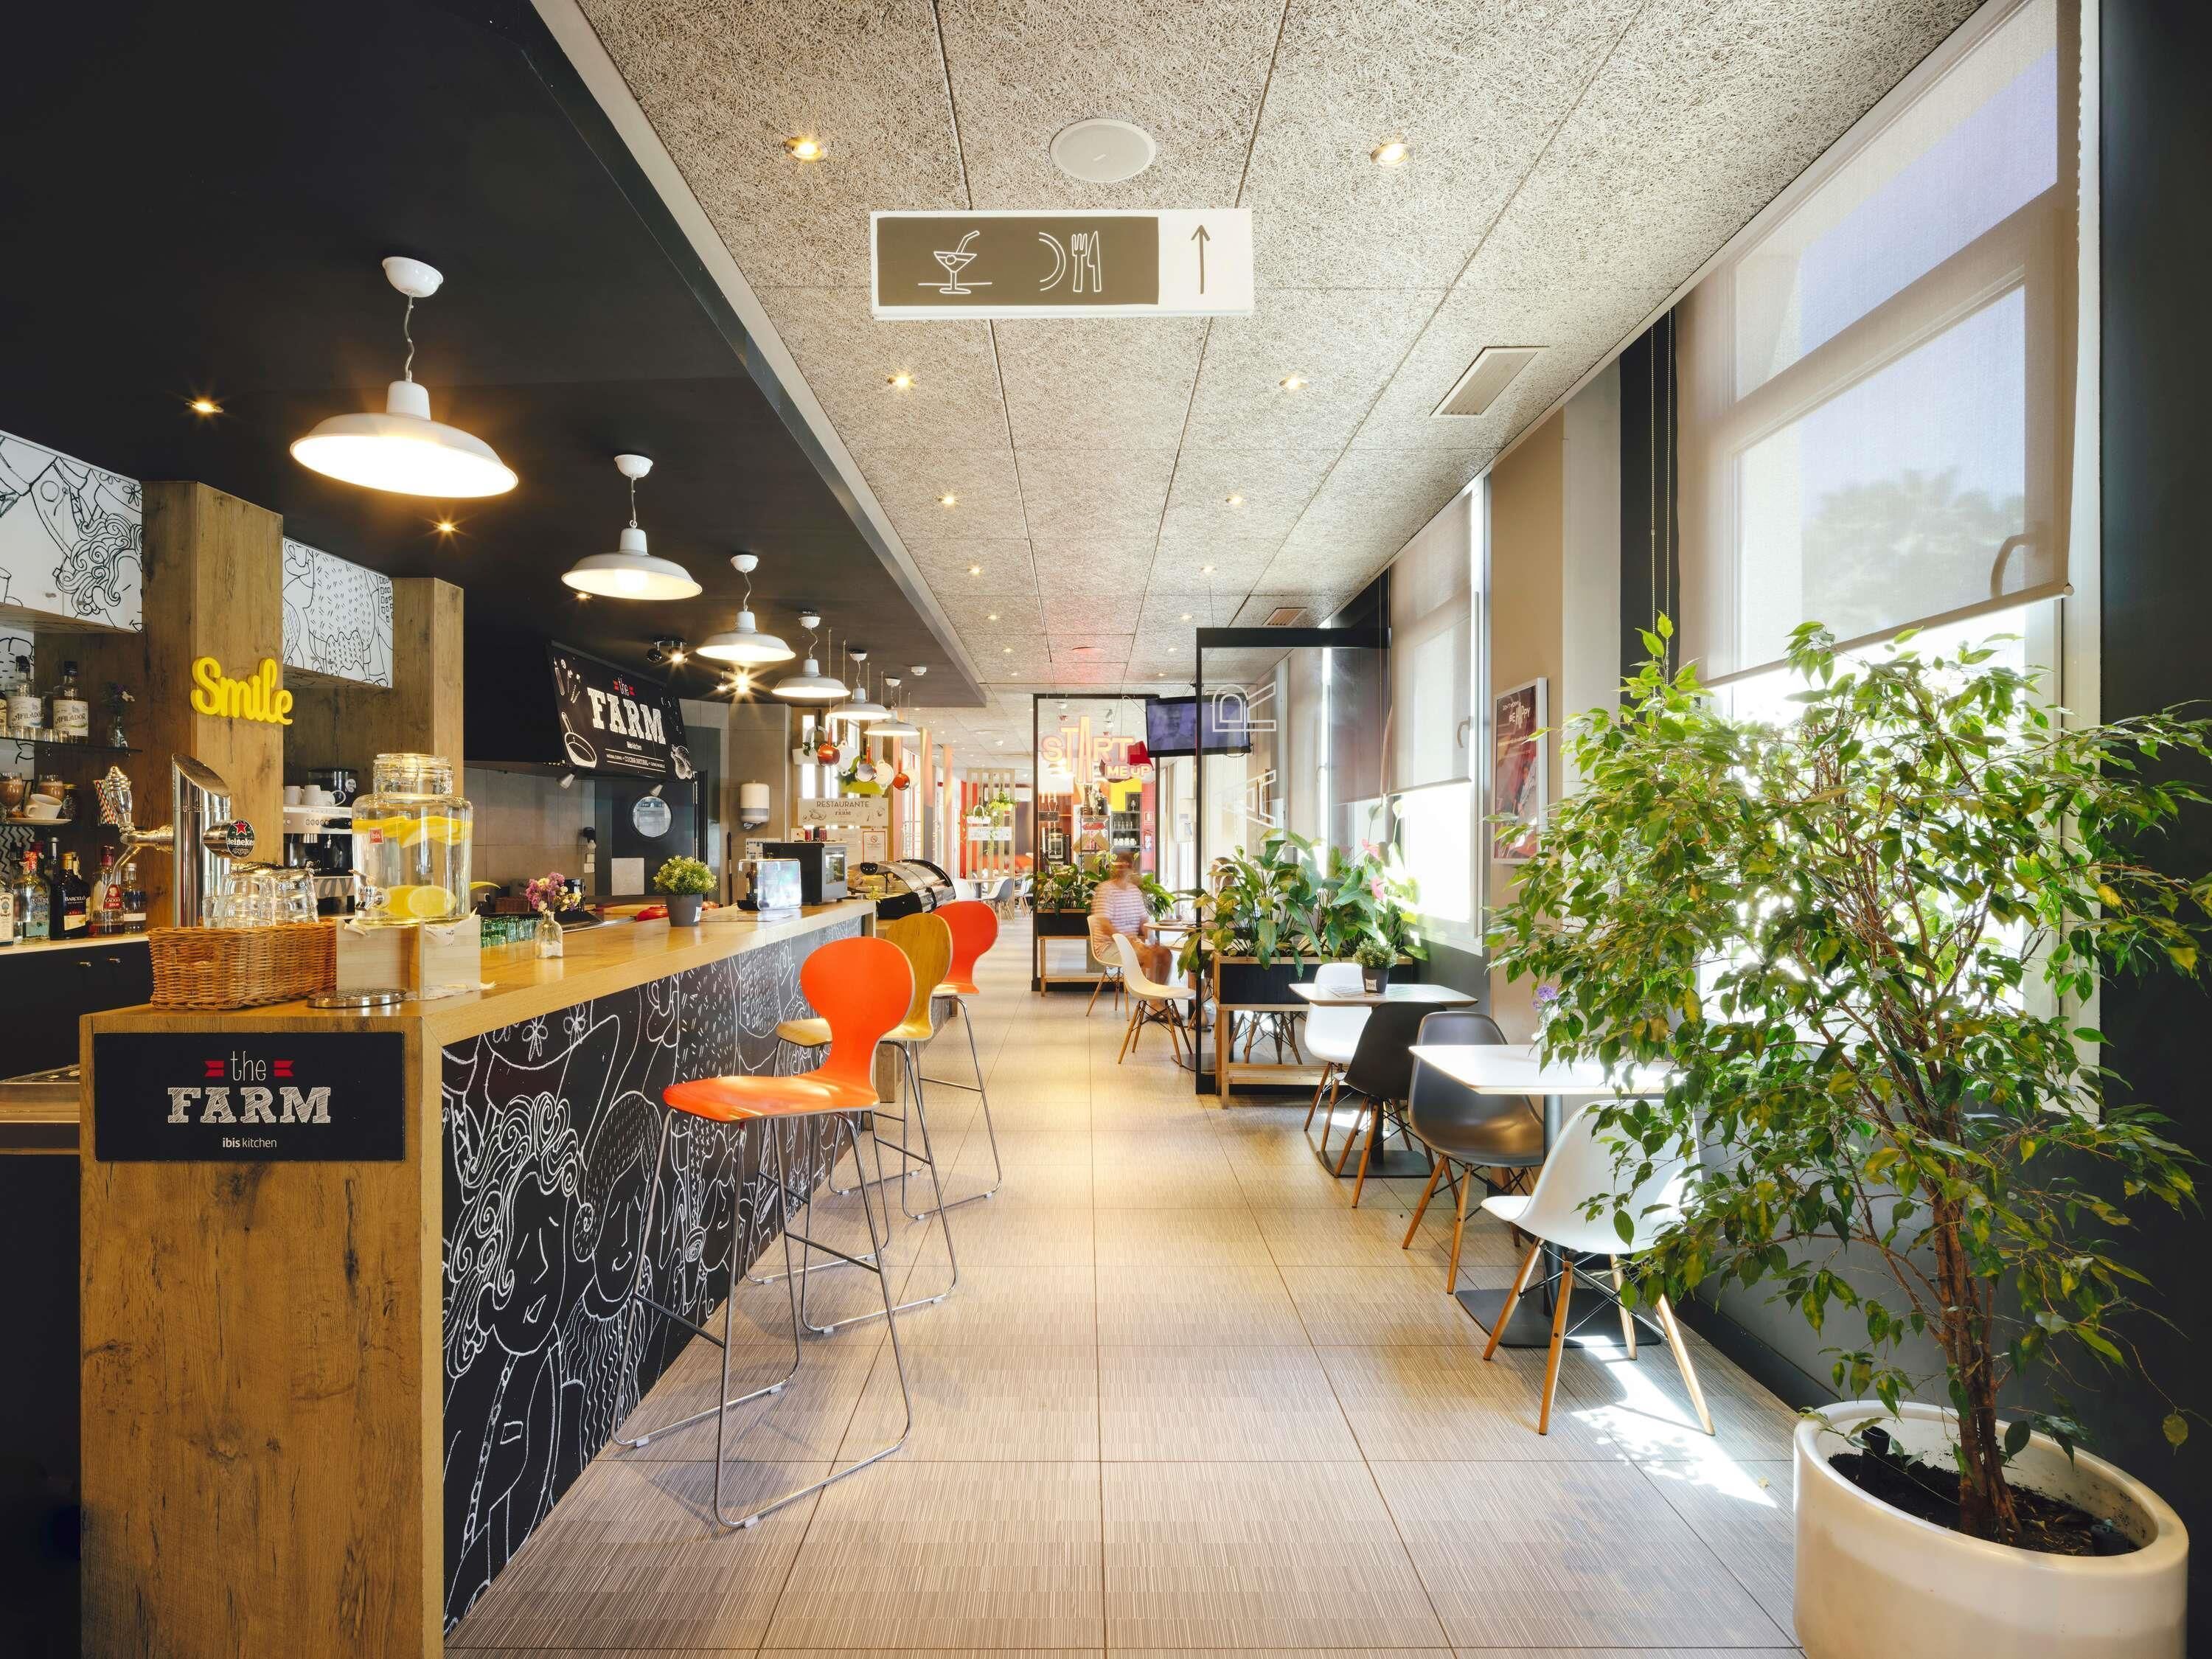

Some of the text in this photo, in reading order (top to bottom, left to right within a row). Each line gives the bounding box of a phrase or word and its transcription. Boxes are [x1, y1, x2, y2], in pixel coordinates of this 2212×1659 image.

[190, 656, 293, 725] Smile
[618, 678, 630, 697] the
[587, 687, 667, 745] FARM
[1042, 716, 1135, 784] START
[1106, 764, 1150, 778] ME UP
[230, 1051, 266, 1081] the
[167, 1087, 331, 1124] FARM
[223, 1137, 277, 1149] ibis kitchen
